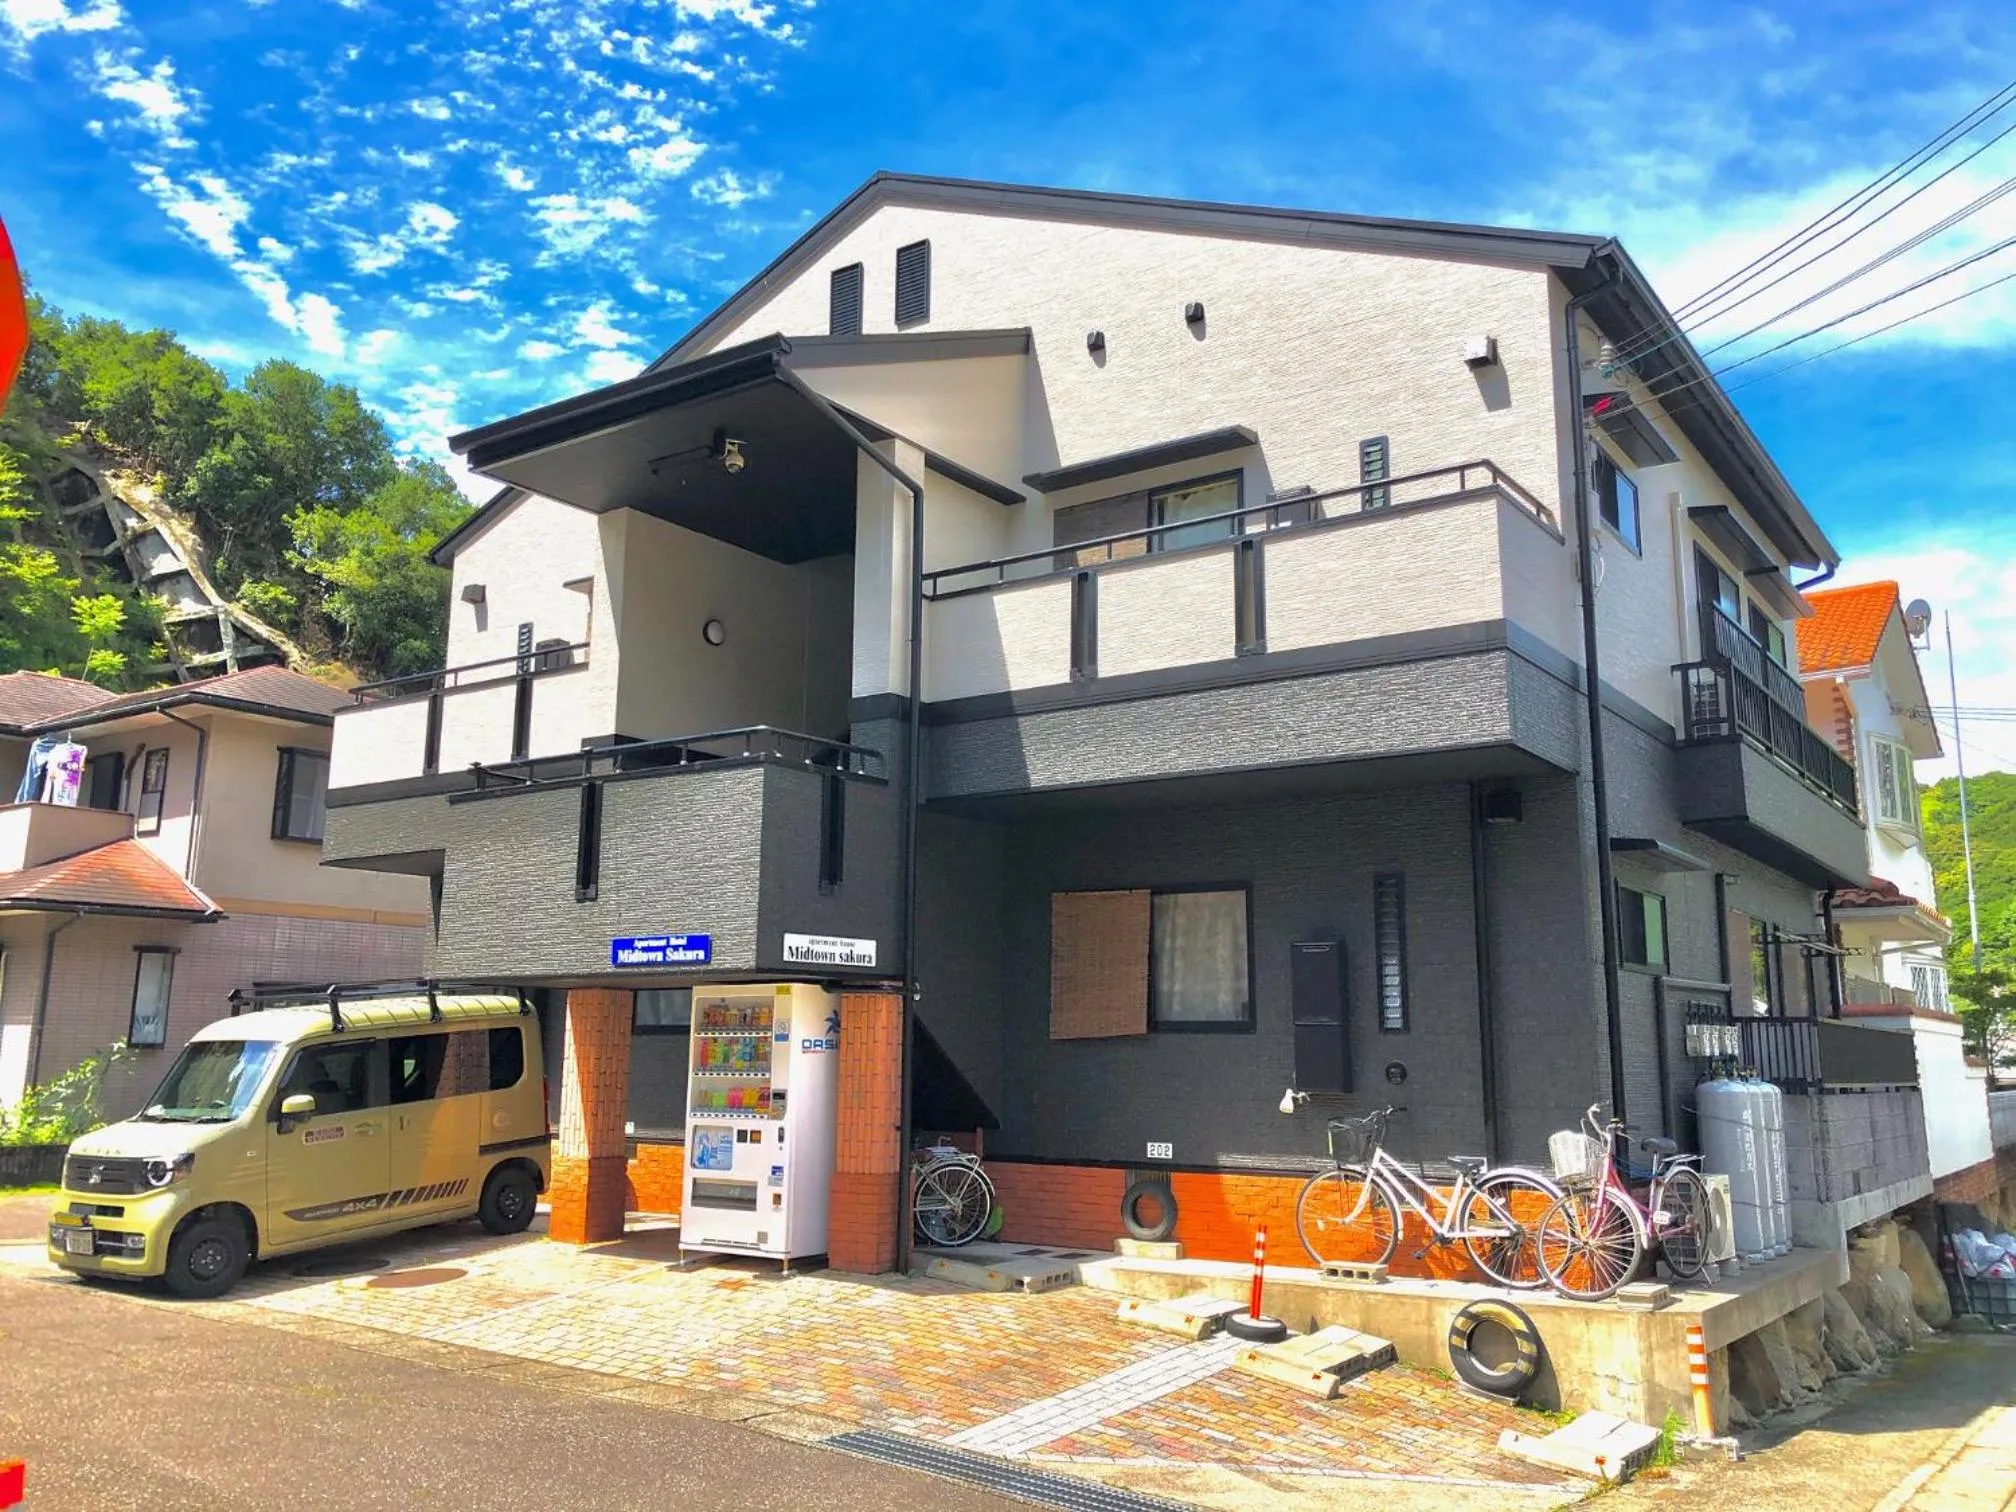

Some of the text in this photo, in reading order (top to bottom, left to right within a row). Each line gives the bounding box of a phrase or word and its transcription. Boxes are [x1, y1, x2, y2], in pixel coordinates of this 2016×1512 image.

[617, 947, 705, 963] Midtown Sakura
[787, 945, 873, 964] Midtown sakura
[1150, 1144, 1170, 1157] 202
